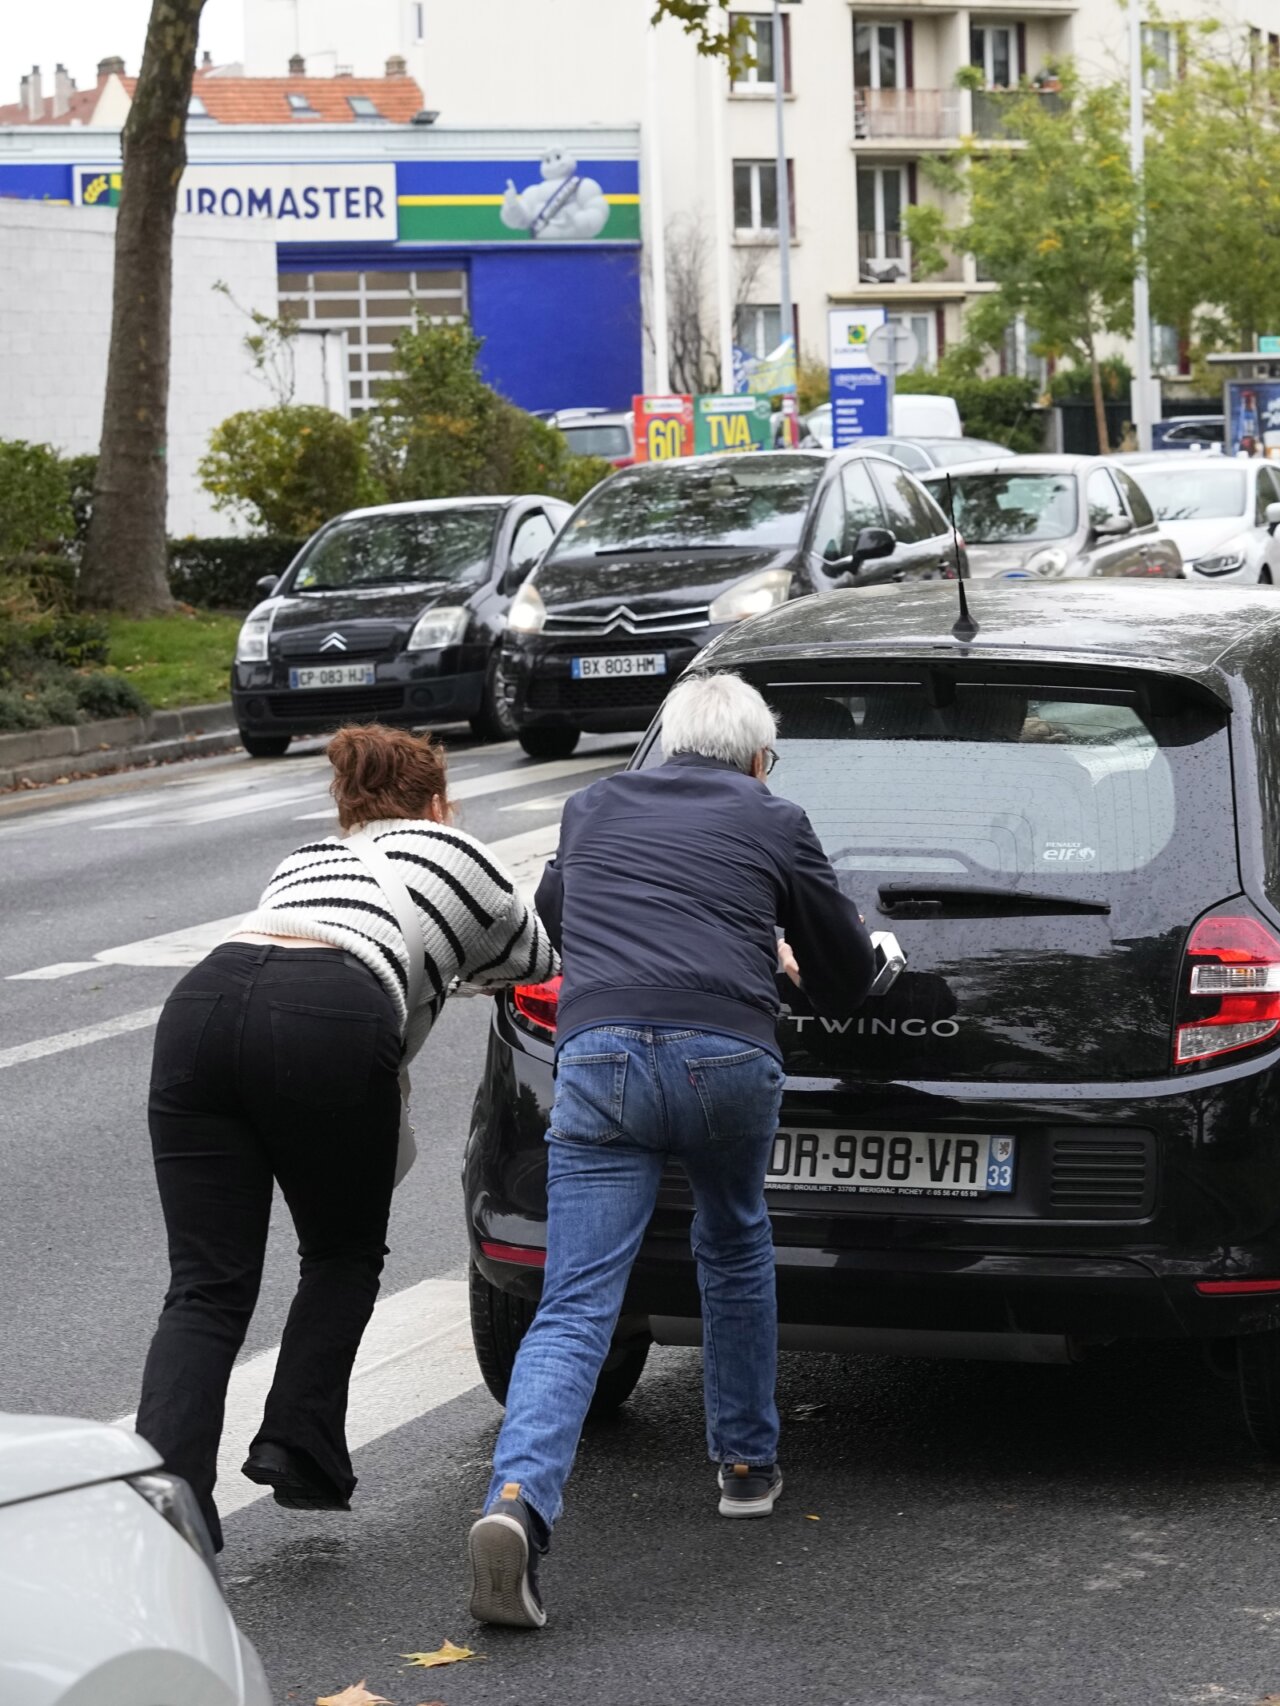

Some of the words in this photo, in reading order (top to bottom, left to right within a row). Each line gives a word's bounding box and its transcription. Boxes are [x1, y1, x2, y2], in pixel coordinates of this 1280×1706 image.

[186, 186, 386, 219] ROMASTER
[705, 414, 752, 448] TVA
[1042, 848, 1077, 861] elf
[787, 1015, 960, 1038] TWINGO
[987, 1165, 1012, 1186] 33
[898, 1188, 924, 1196] PICHEY
